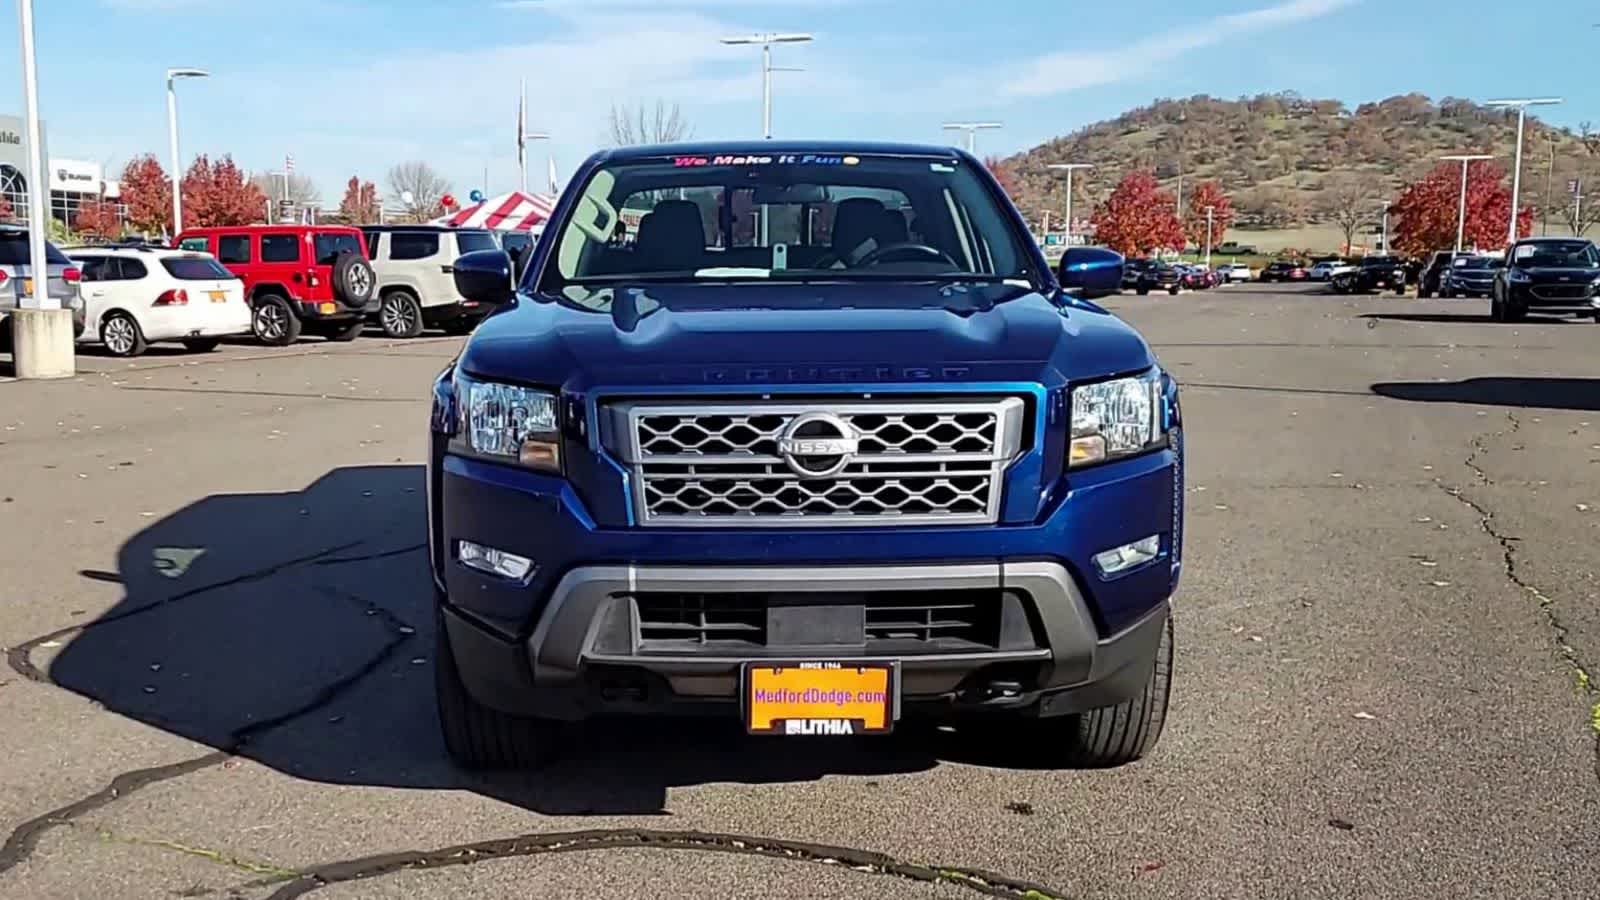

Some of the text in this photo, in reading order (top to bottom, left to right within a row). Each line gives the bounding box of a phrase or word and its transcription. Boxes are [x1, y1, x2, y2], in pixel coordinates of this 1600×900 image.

[673, 155, 840, 167] We Make It Fun
[779, 440, 857, 453] NISSA
[755, 688, 887, 706] MedfordDodge.com
[801, 719, 853, 734] LITHIA
